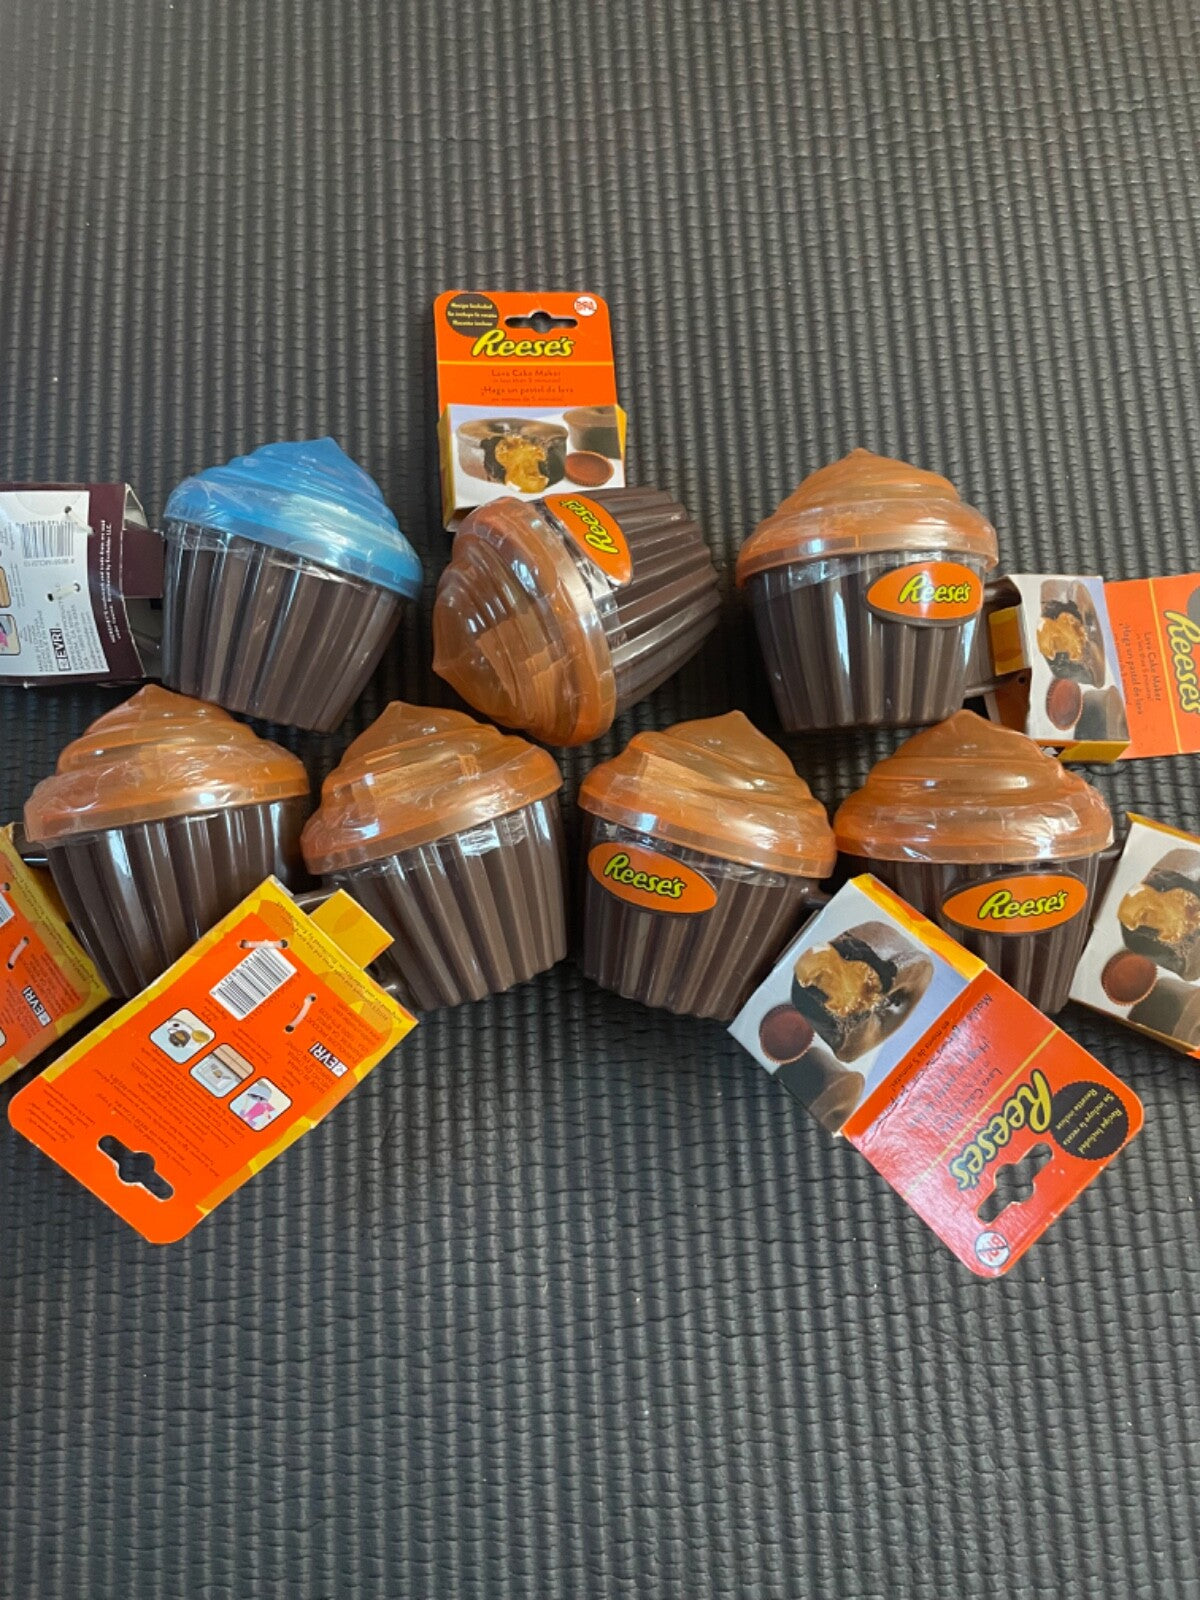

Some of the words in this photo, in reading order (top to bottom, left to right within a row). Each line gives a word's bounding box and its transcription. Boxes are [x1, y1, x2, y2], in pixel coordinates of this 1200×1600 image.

[471, 329, 576, 358] Reese's
[560, 500, 620, 554] Reese's
[899, 570, 972, 603] Reese's
[51, 628, 67, 660] EVRI
[604, 852, 687, 898] Reese's
[978, 889, 1068, 919] Reese's
[22, 986, 44, 1015] EVRI
[309, 1041, 338, 1069] EVRI
[950, 1068, 1051, 1191] Reese's
